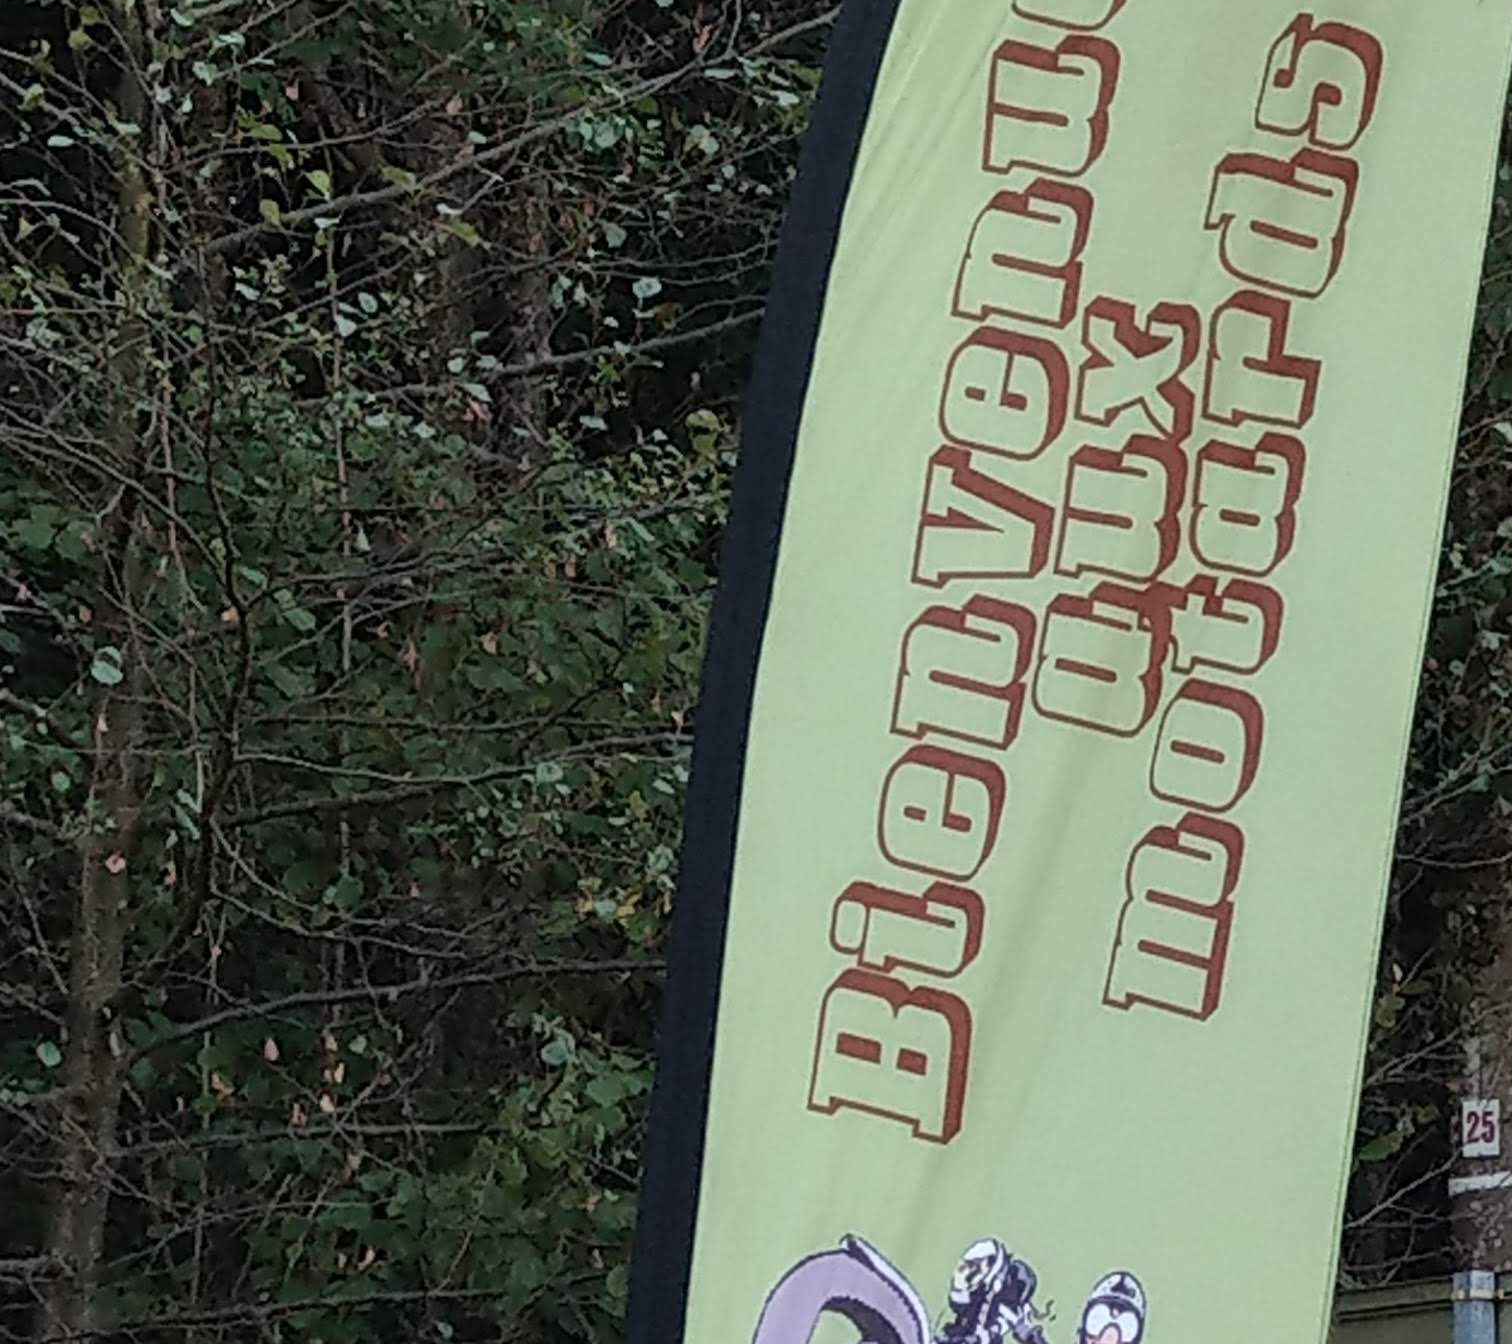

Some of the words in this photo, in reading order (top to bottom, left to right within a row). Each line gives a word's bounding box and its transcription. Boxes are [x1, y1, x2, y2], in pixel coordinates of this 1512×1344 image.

[1031, 296, 1200, 739] aux
[1102, 12, 1385, 1022] motards
[1466, 1110, 1496, 1144] 25
